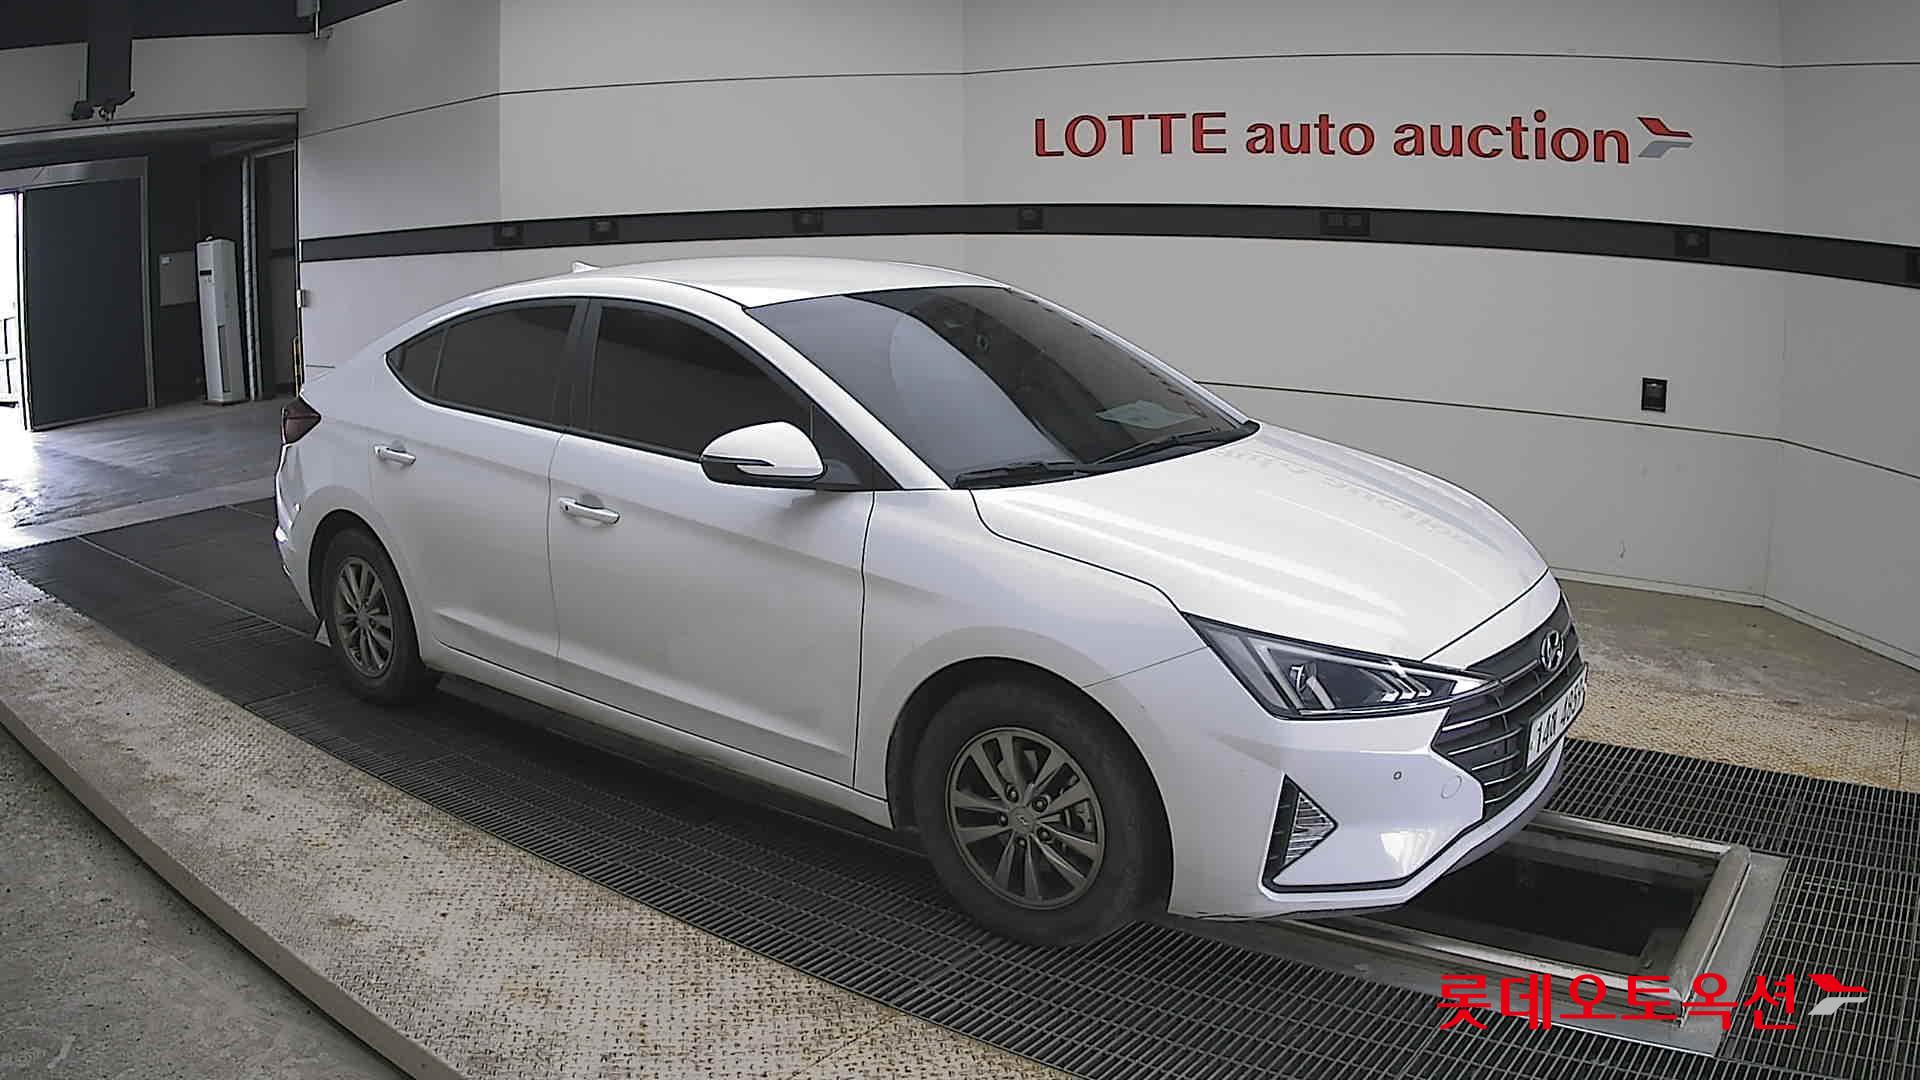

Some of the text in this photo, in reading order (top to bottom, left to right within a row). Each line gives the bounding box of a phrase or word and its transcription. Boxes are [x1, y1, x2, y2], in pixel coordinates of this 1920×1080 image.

[1034, 109, 1631, 164] LOTTE auto auction
